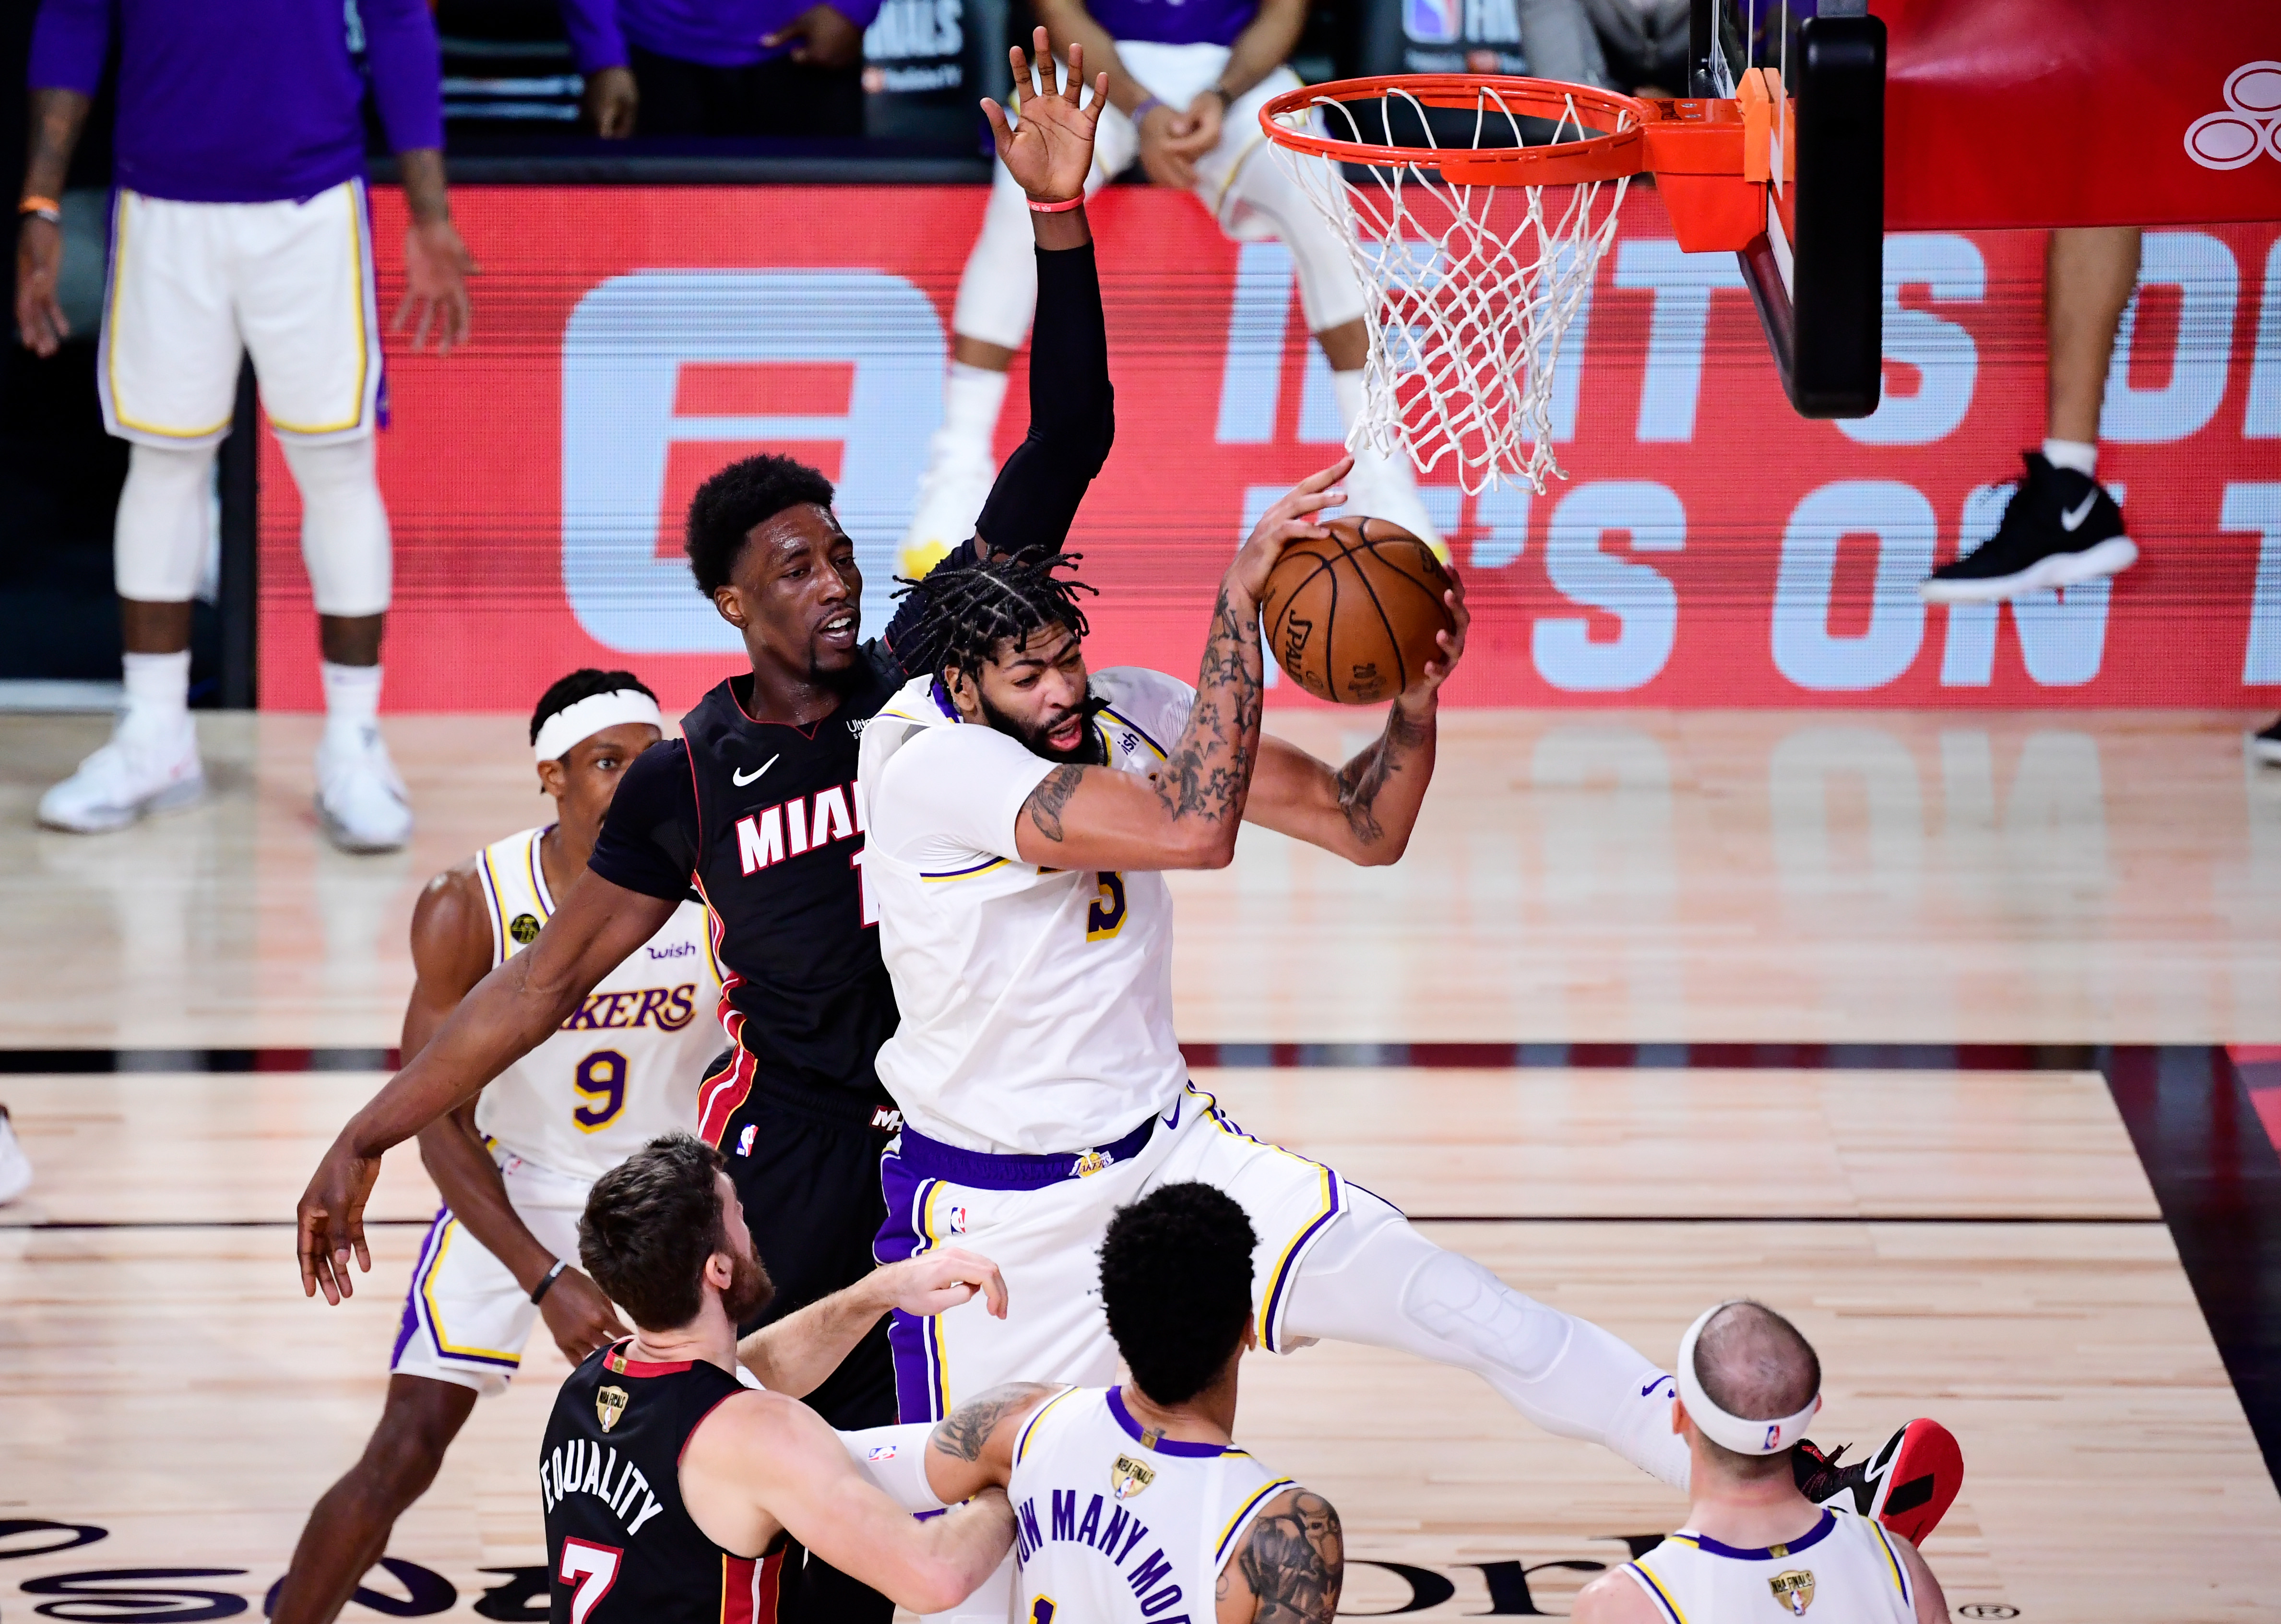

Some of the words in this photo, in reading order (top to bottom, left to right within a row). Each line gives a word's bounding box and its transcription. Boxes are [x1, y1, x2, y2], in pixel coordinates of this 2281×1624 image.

[1521, 233, 1987, 445] ITS
[2096, 230, 2281, 441] O
[647, 941, 696, 959] wish
[558, 983, 698, 1032] KERS
[573, 1048, 630, 1134] 9
[540, 1439, 664, 1536] EQUALITY
[1051, 1489, 1149, 1567] MANY
[558, 1535, 624, 1624] 7
